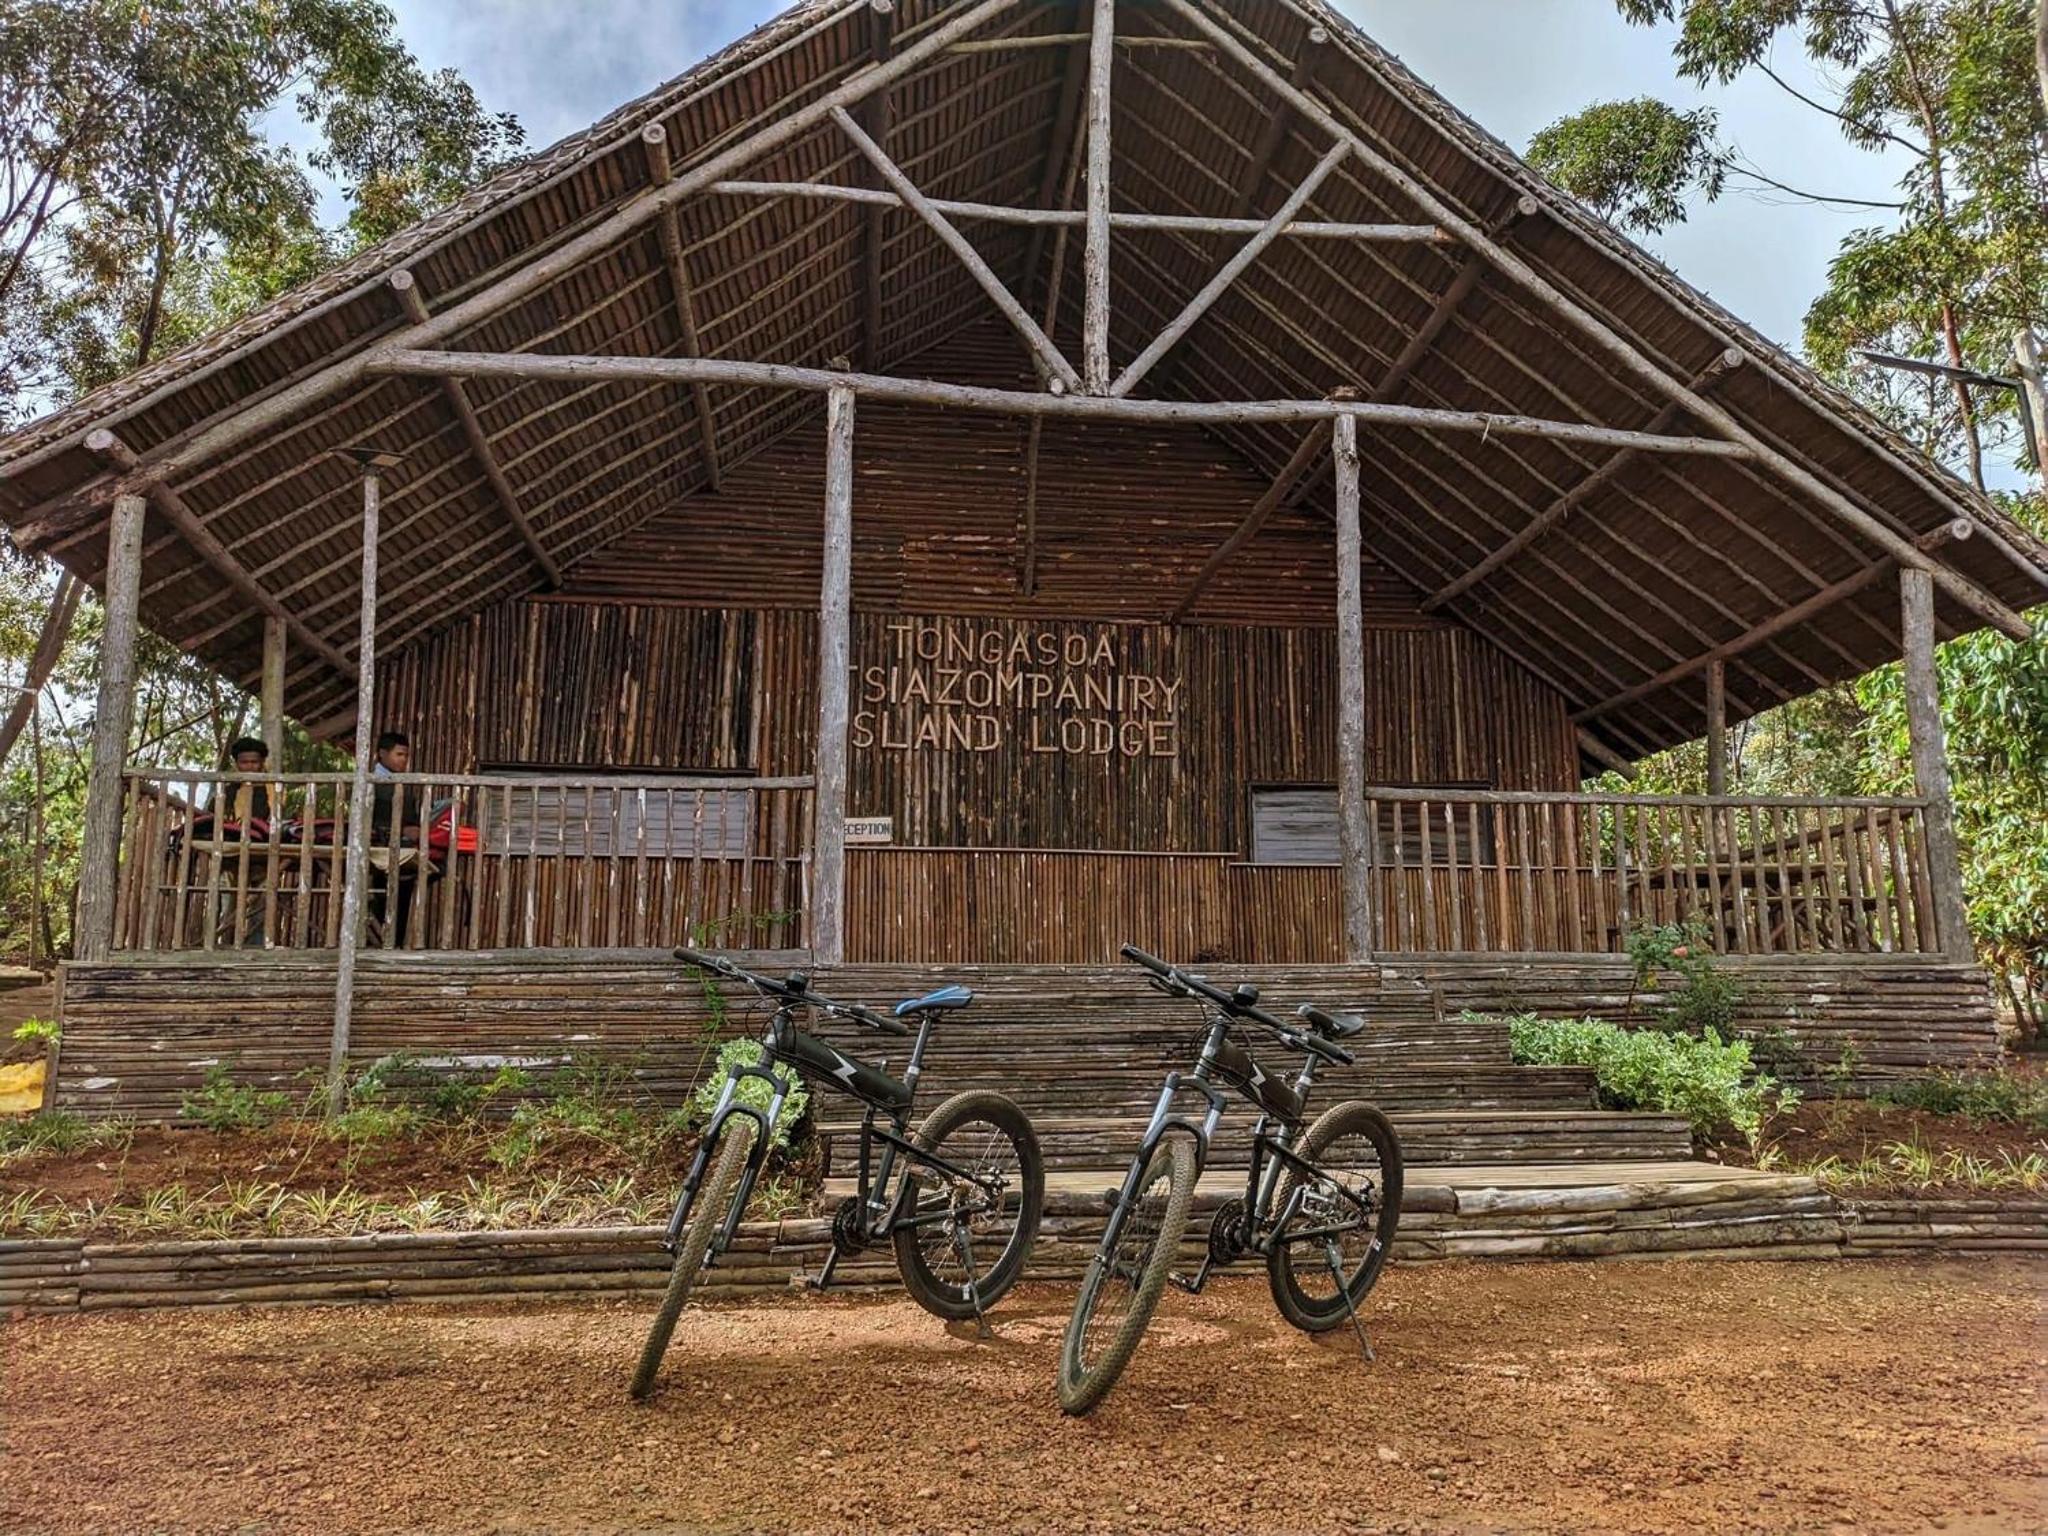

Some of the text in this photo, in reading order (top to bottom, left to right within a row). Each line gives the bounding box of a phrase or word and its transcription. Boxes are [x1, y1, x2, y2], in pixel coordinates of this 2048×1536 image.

[887, 624, 1115, 667] TONGASOA
[849, 664, 1182, 713] SIAZOMPANIRY
[852, 710, 1177, 757] SLAND LODGE
[844, 822, 890, 835] ECEPTION
